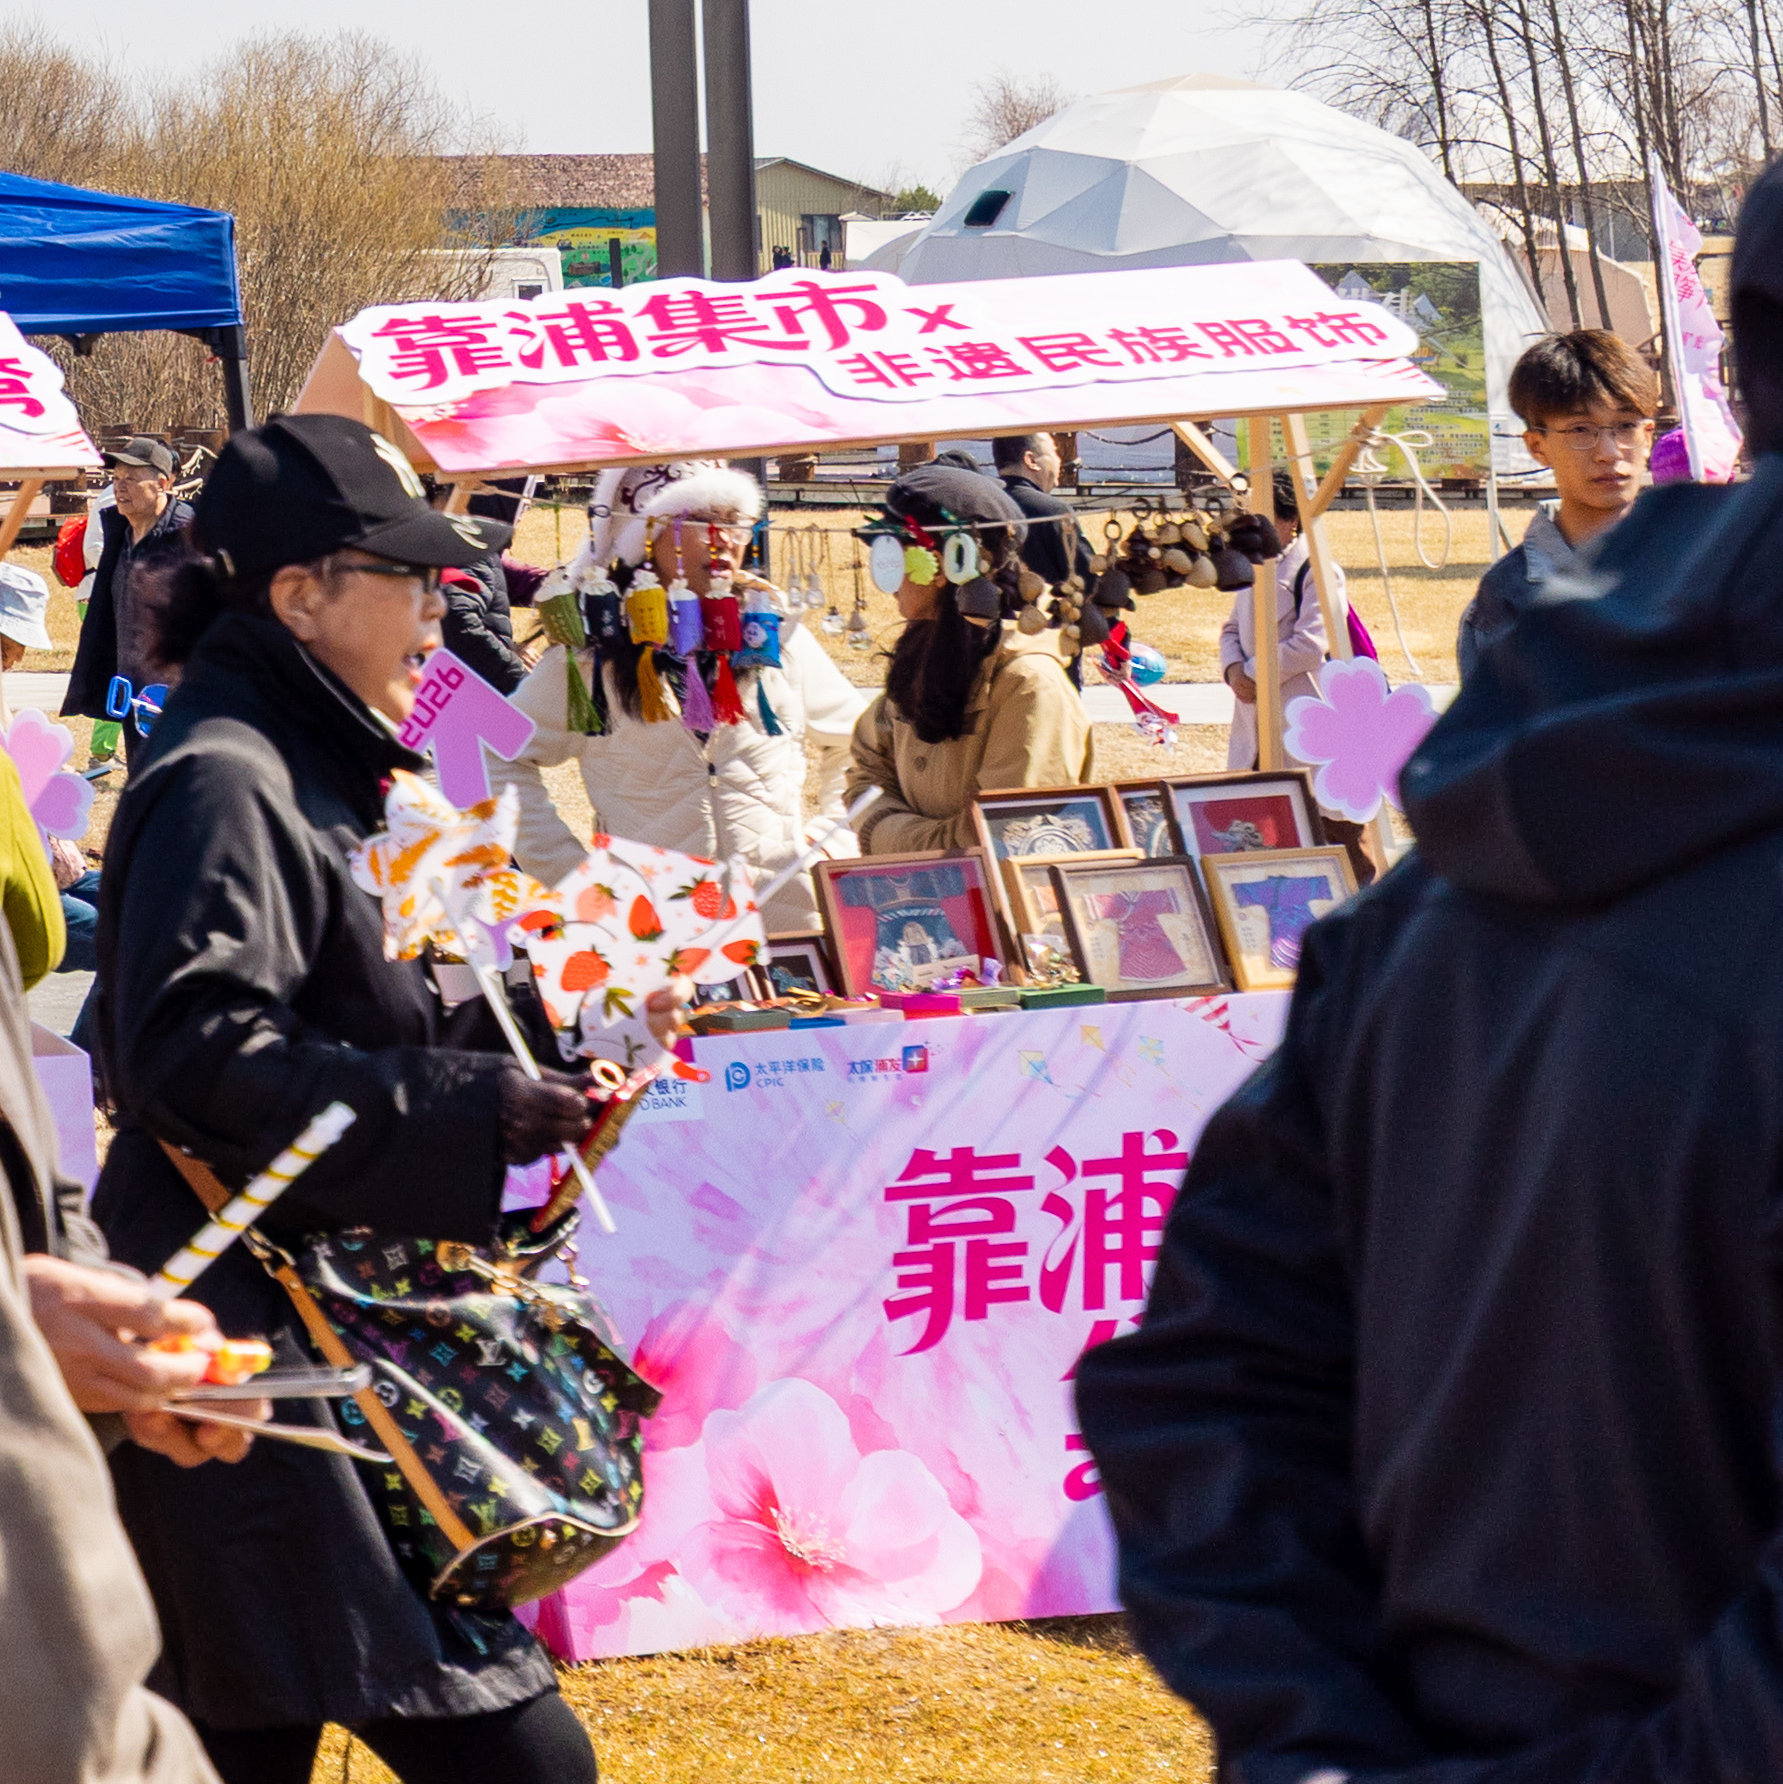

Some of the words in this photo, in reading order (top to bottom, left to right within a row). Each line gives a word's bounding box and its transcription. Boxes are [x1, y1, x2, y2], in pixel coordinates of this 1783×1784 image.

[835, 311, 1390, 389] 非遗民族服饰
[399, 666, 465, 748] 2026
[755, 1057, 825, 1077] 太平洋保险
[756, 1076, 785, 1089] CPIC
[883, 1128, 1189, 1358] 靠浦
